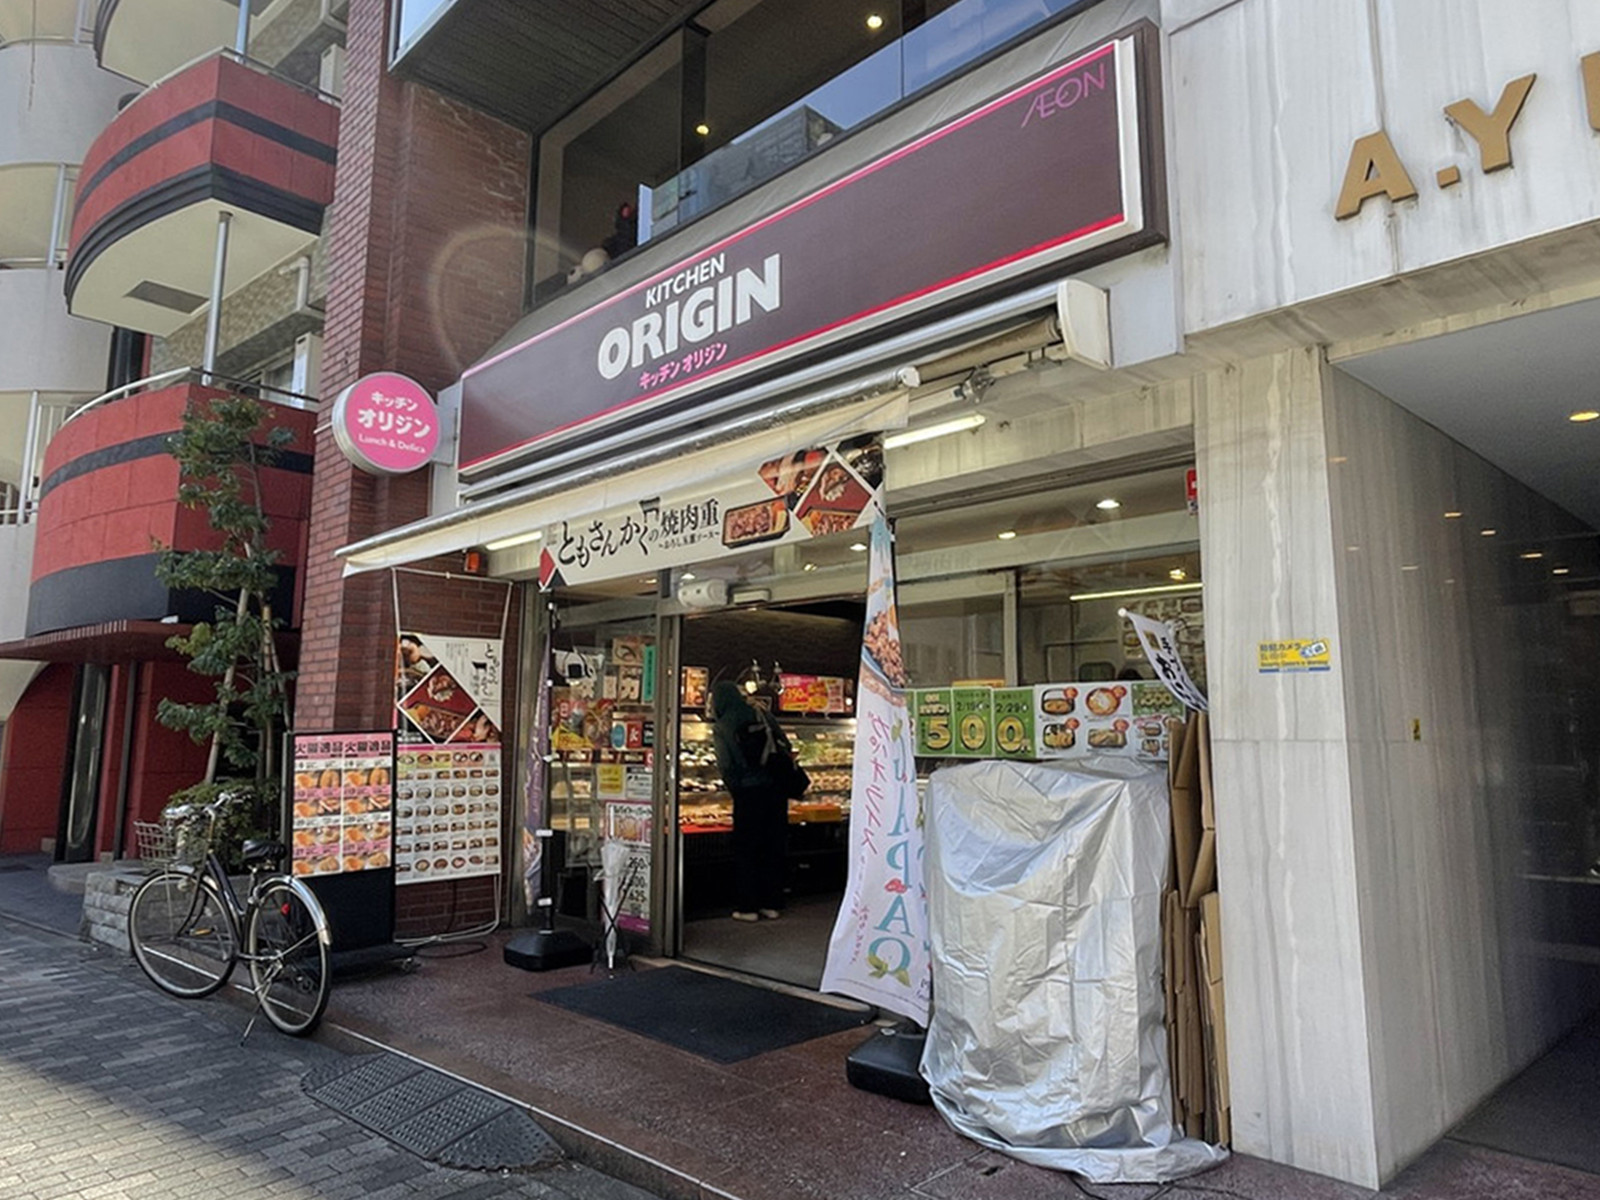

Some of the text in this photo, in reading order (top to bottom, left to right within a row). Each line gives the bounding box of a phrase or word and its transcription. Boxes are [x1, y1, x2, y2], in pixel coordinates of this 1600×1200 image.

[1335, 52, 1600, 221] A.Y
[645, 252, 726, 309] KITCHEN
[597, 253, 781, 380] ORIGIN
[357, 408, 431, 438] オリジン
[371, 391, 419, 412] キッチン
[358, 433, 387, 446] Lunch
[388, 439, 396, 448] &
